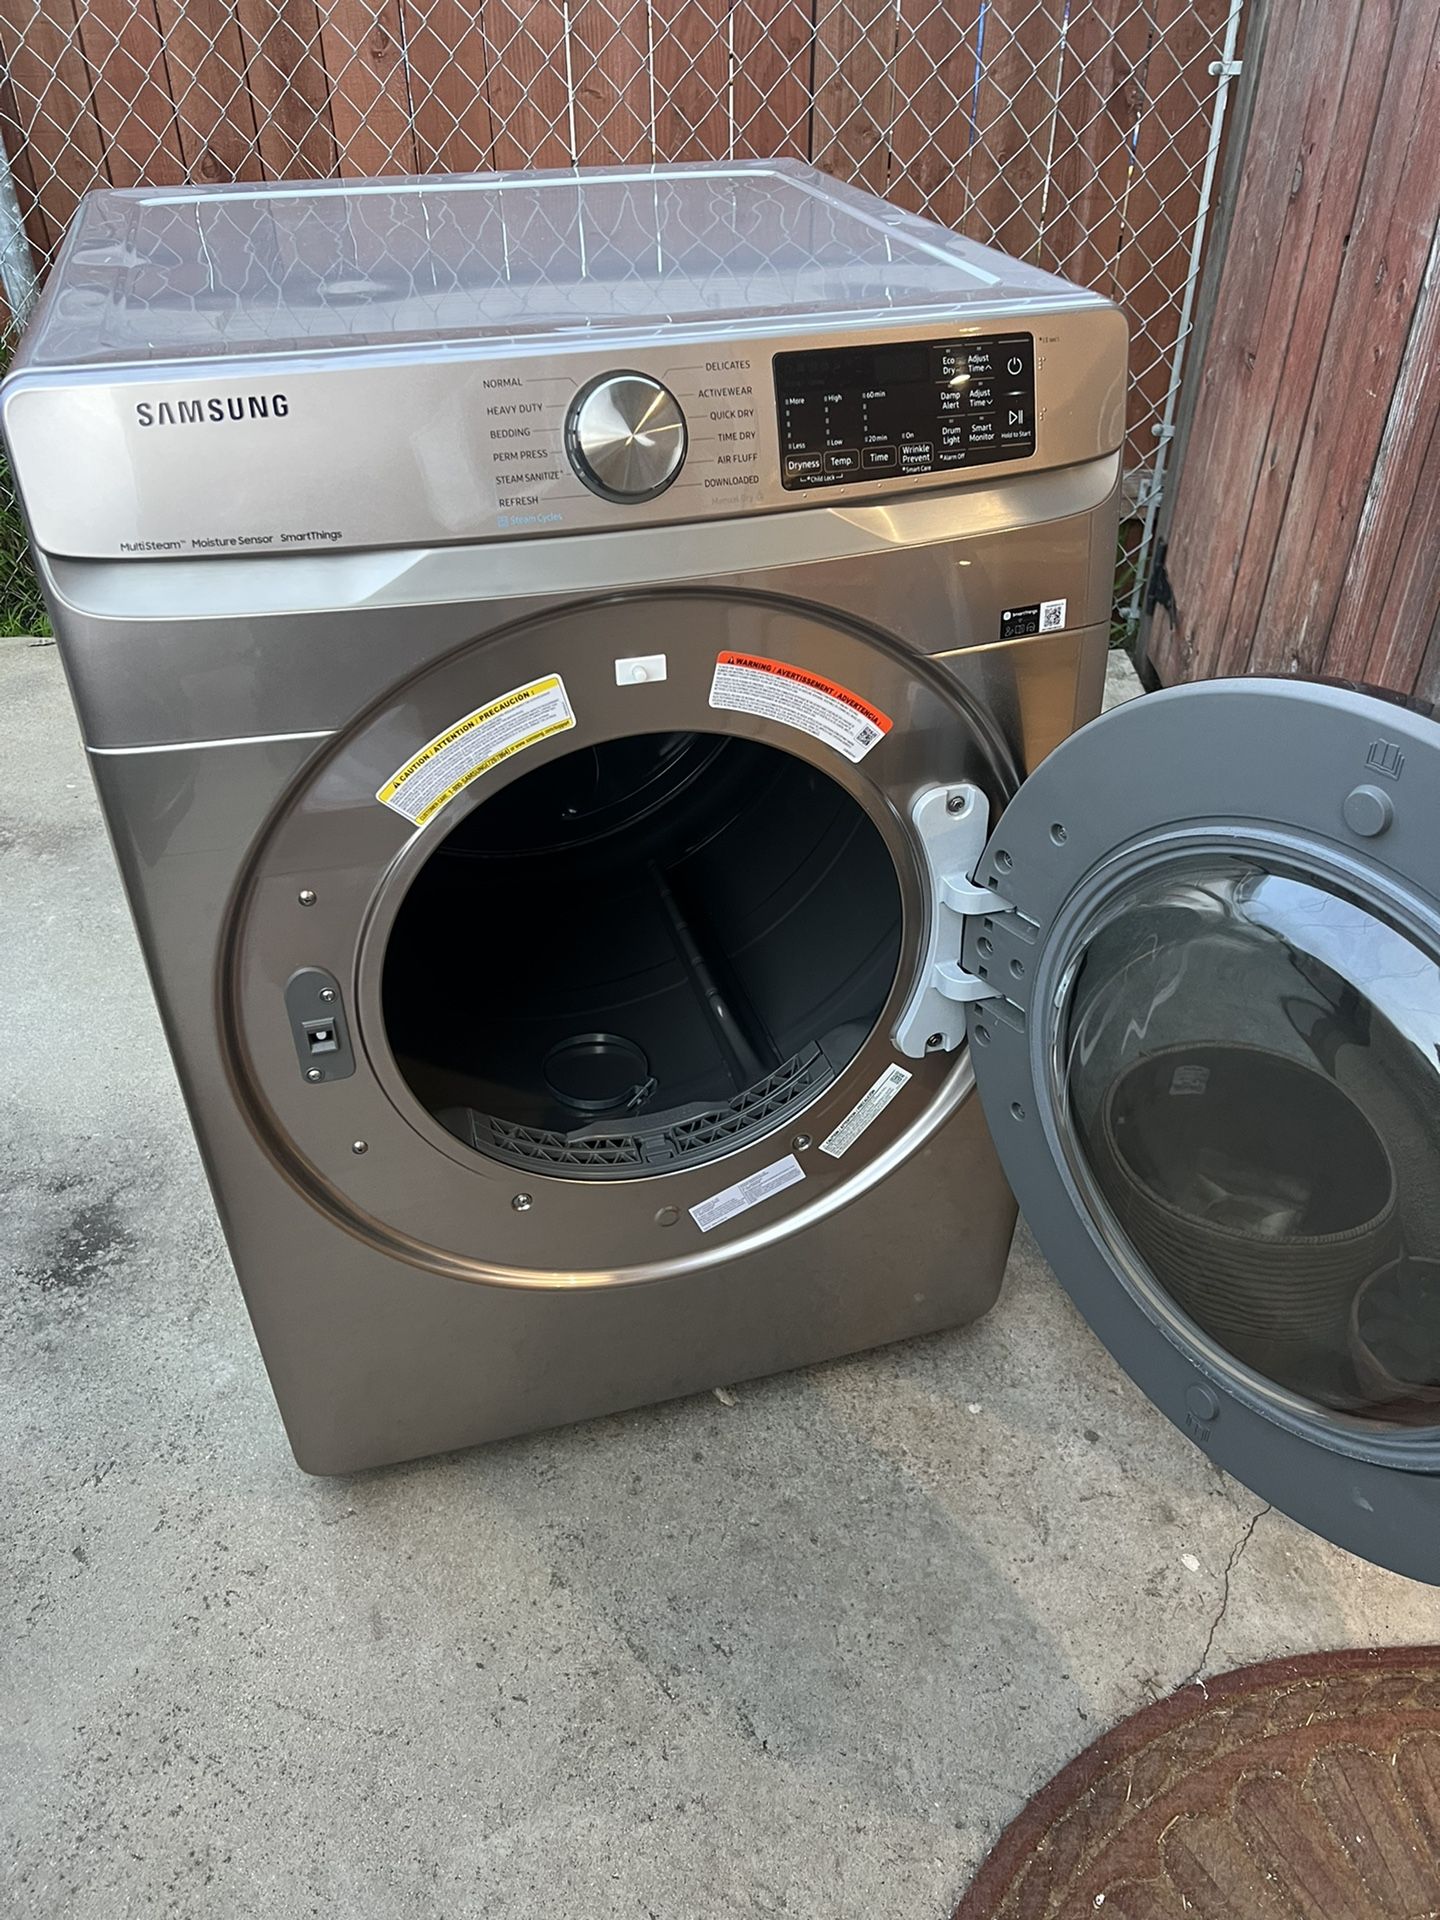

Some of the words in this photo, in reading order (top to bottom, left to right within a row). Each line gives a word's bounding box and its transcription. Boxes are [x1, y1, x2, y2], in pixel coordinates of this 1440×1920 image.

[968, 354, 989, 363] Adjust
[705, 360, 750, 371] DELICATES
[943, 366, 955, 376] Dry
[968, 364, 984, 372] Time
[483, 377, 522, 389] NORMAL
[698, 386, 752, 398] ACTIVEWEAR
[941, 392, 961, 402] Damp
[969, 389, 990, 398] Adjust
[789, 397, 805, 405] More
[828, 394, 842, 403] High
[970, 399, 985, 407] Time
[136, 394, 289, 427] SAMSUNG
[486, 405, 518, 416] HEAVY
[520, 403, 543, 414] DUTY
[942, 401, 959, 410] Alert
[710, 410, 735, 421] QUICK
[736, 409, 754, 419] DRY
[490, 427, 531, 439] BEDDING
[972, 424, 992, 432] Smart
[717, 433, 737, 442] TIME
[738, 431, 756, 441] DRY
[943, 436, 960, 446] Light
[969, 433, 995, 442] Monitor
[902, 444, 930, 454] Wrinkle
[493, 451, 518, 462] PERM
[520, 449, 548, 460] PRESS
[717, 455, 731, 465] AIR
[732, 453, 758, 463] FLUFF
[870, 453, 888, 462] Time
[902, 454, 930, 463] Prevent
[788, 459, 820, 471] Dryness
[830, 457, 853, 467] Temp.
[496, 474, 524, 485] STEAM
[704, 475, 759, 487] DOWNLOADED
[810, 474, 824, 482] Child
[498, 495, 539, 508] REFRESH
[511, 514, 536, 525] Steam
[537, 512, 563, 524] Cycles
[192, 537, 237, 548] Moisture
[238, 536, 273, 545] Sensor
[280, 530, 342, 542] SmartThings
[736, 658, 772, 672] WARNING
[777, 668, 834, 695] AVERTISSEMENT
[837, 693, 879, 725] ADVERTENCIA
[400, 754, 430, 781] CAUTION
[434, 722, 475, 753] ATTENTION
[479, 691, 530, 722] PRECAUCIÓN
